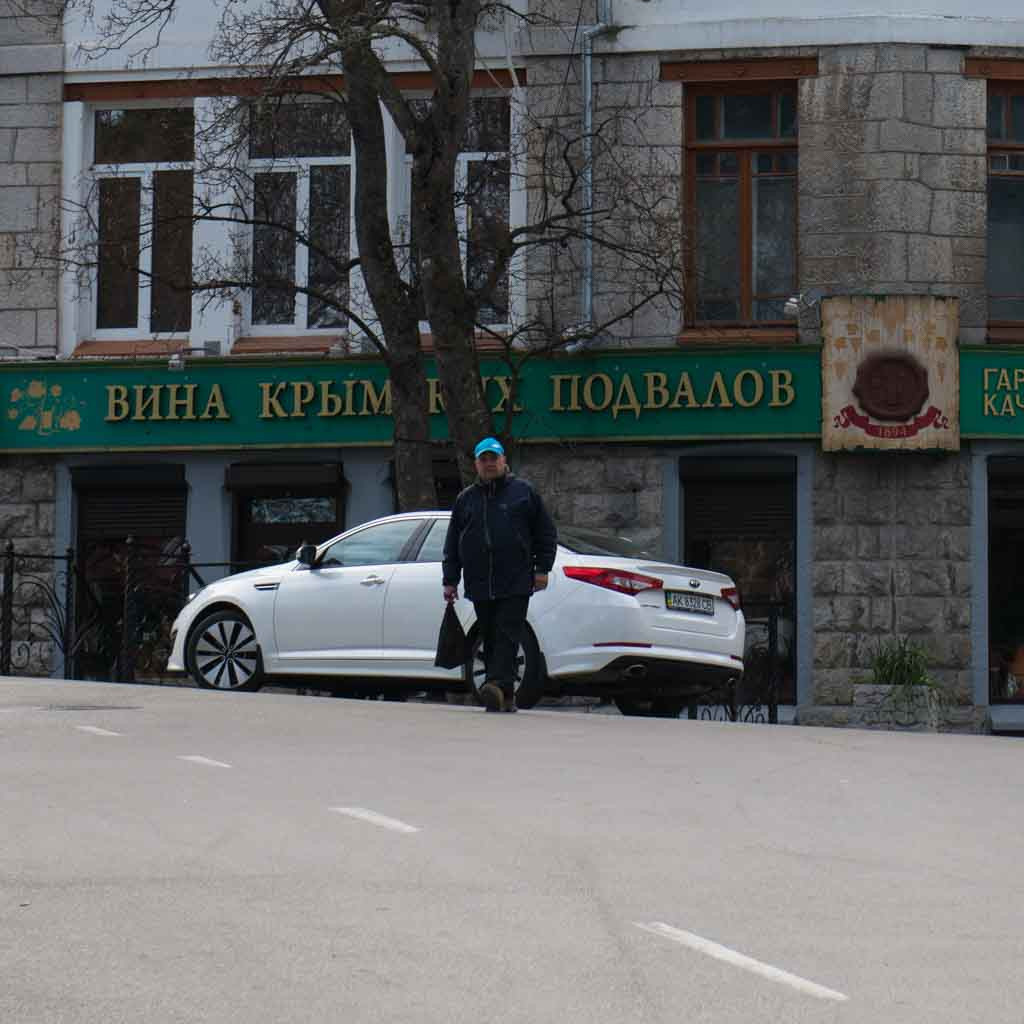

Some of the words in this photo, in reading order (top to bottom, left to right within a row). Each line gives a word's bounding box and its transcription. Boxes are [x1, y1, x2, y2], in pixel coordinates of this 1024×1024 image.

[104, 383, 230, 421] ВИНА
[257, 376, 523, 418] КРЫМКХ
[550, 370, 796, 419] ПОДВАЛОВ
